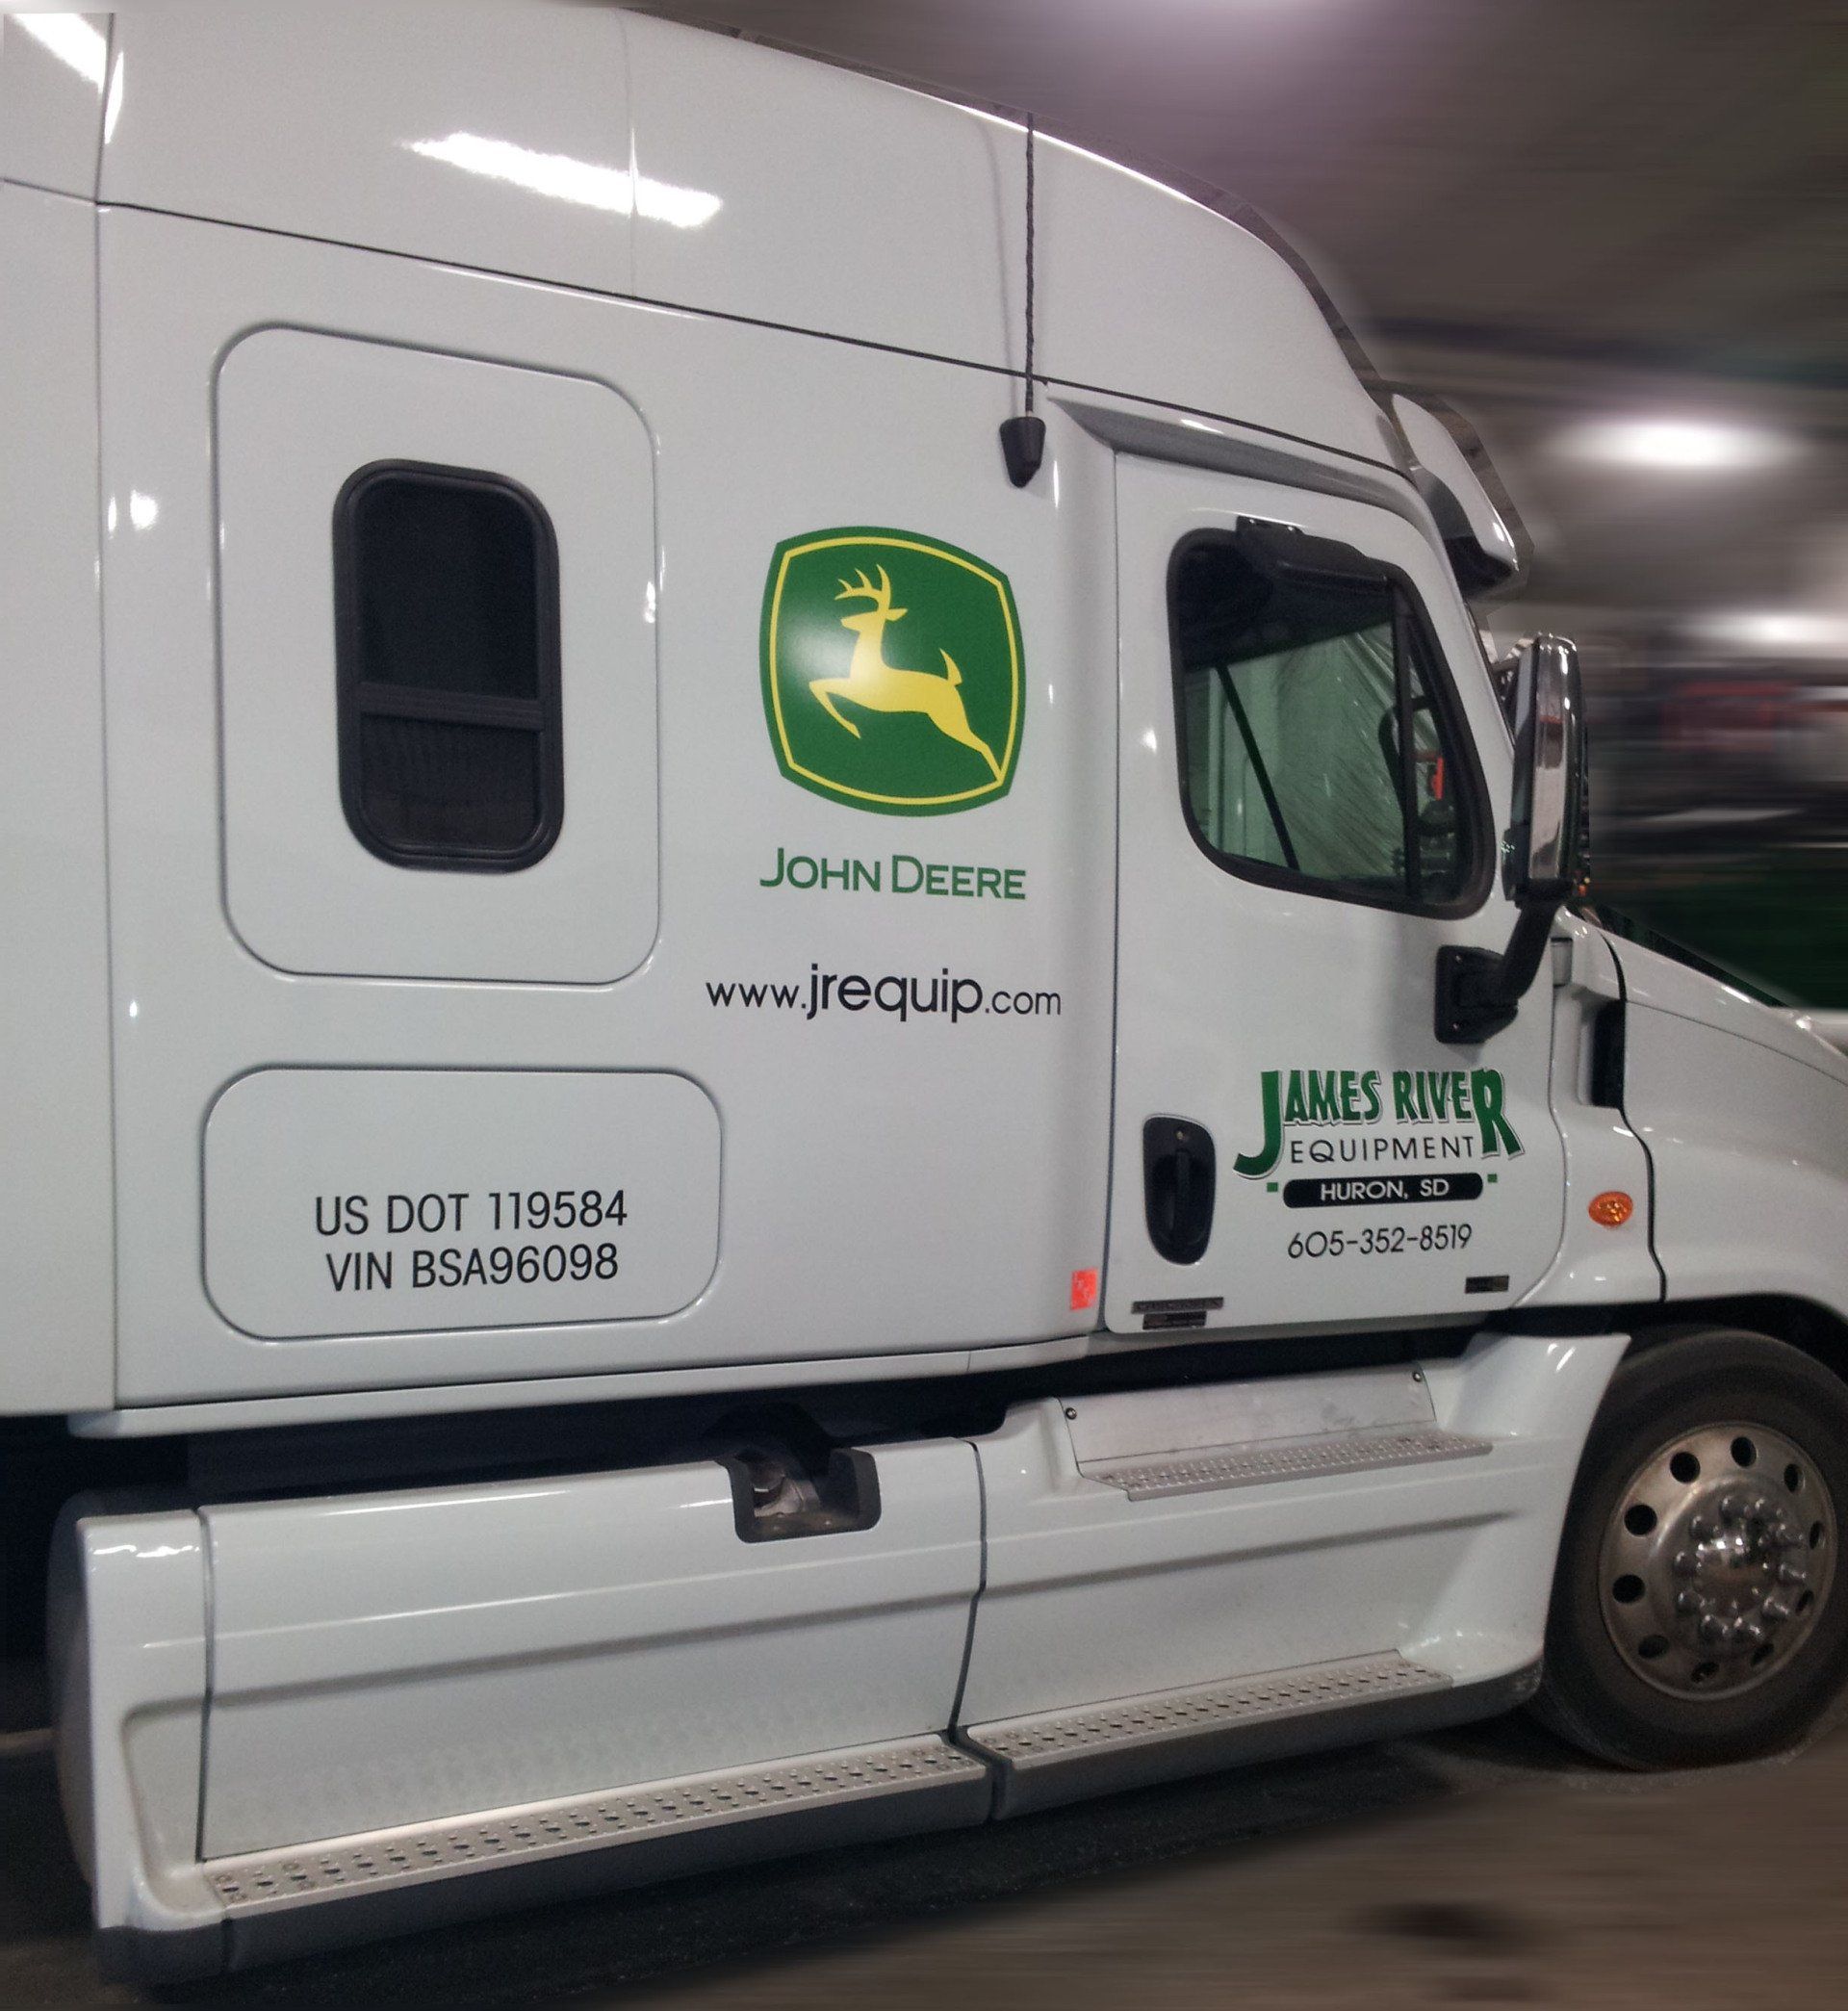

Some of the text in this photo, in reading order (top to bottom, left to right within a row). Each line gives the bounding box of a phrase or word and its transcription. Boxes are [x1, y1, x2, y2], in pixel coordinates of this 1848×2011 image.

[760, 848, 1027, 900] JOHN DEERE
[706, 964, 1063, 1024] www.jrequip.com
[1233, 1068, 1526, 1179] JAMES RIVER
[1291, 1135, 1475, 1164] EQUIPMENT
[316, 1190, 629, 1237] US DOT 119584
[1320, 1178, 1450, 1201] HURON, SD
[1287, 1223, 1474, 1259] 605-352-8519
[326, 1242, 620, 1292] VIN BSA96098
